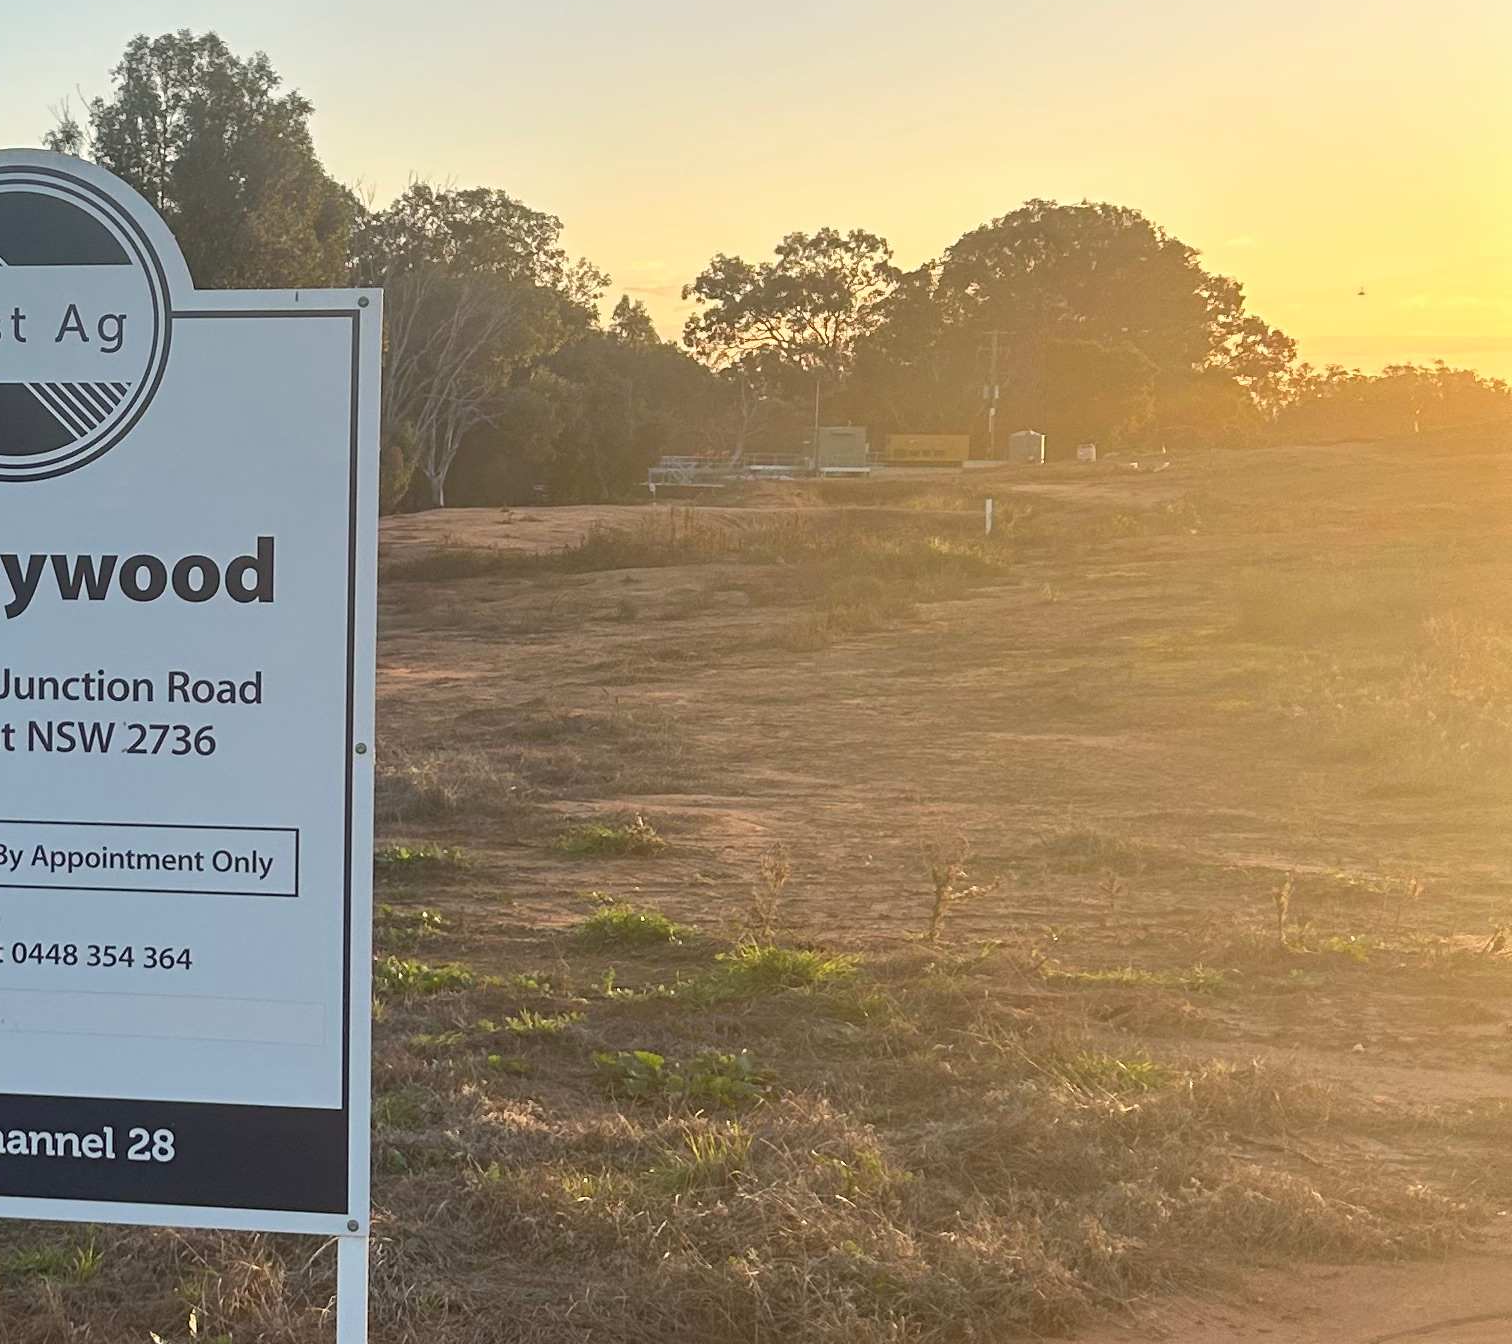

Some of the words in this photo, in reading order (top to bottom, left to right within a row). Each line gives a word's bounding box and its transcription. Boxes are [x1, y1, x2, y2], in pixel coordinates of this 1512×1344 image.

[54, 303, 127, 354] Ag
[168, 670, 262, 705] Road
[28, 720, 116, 754] NSW
[126, 723, 216, 756] 2736
[30, 844, 205, 874] Appointment
[212, 849, 274, 881] Only
[11, 942, 79, 966] 0448
[86, 944, 135, 968] 354
[143, 946, 193, 971] 364
[127, 1127, 175, 1162] 28
